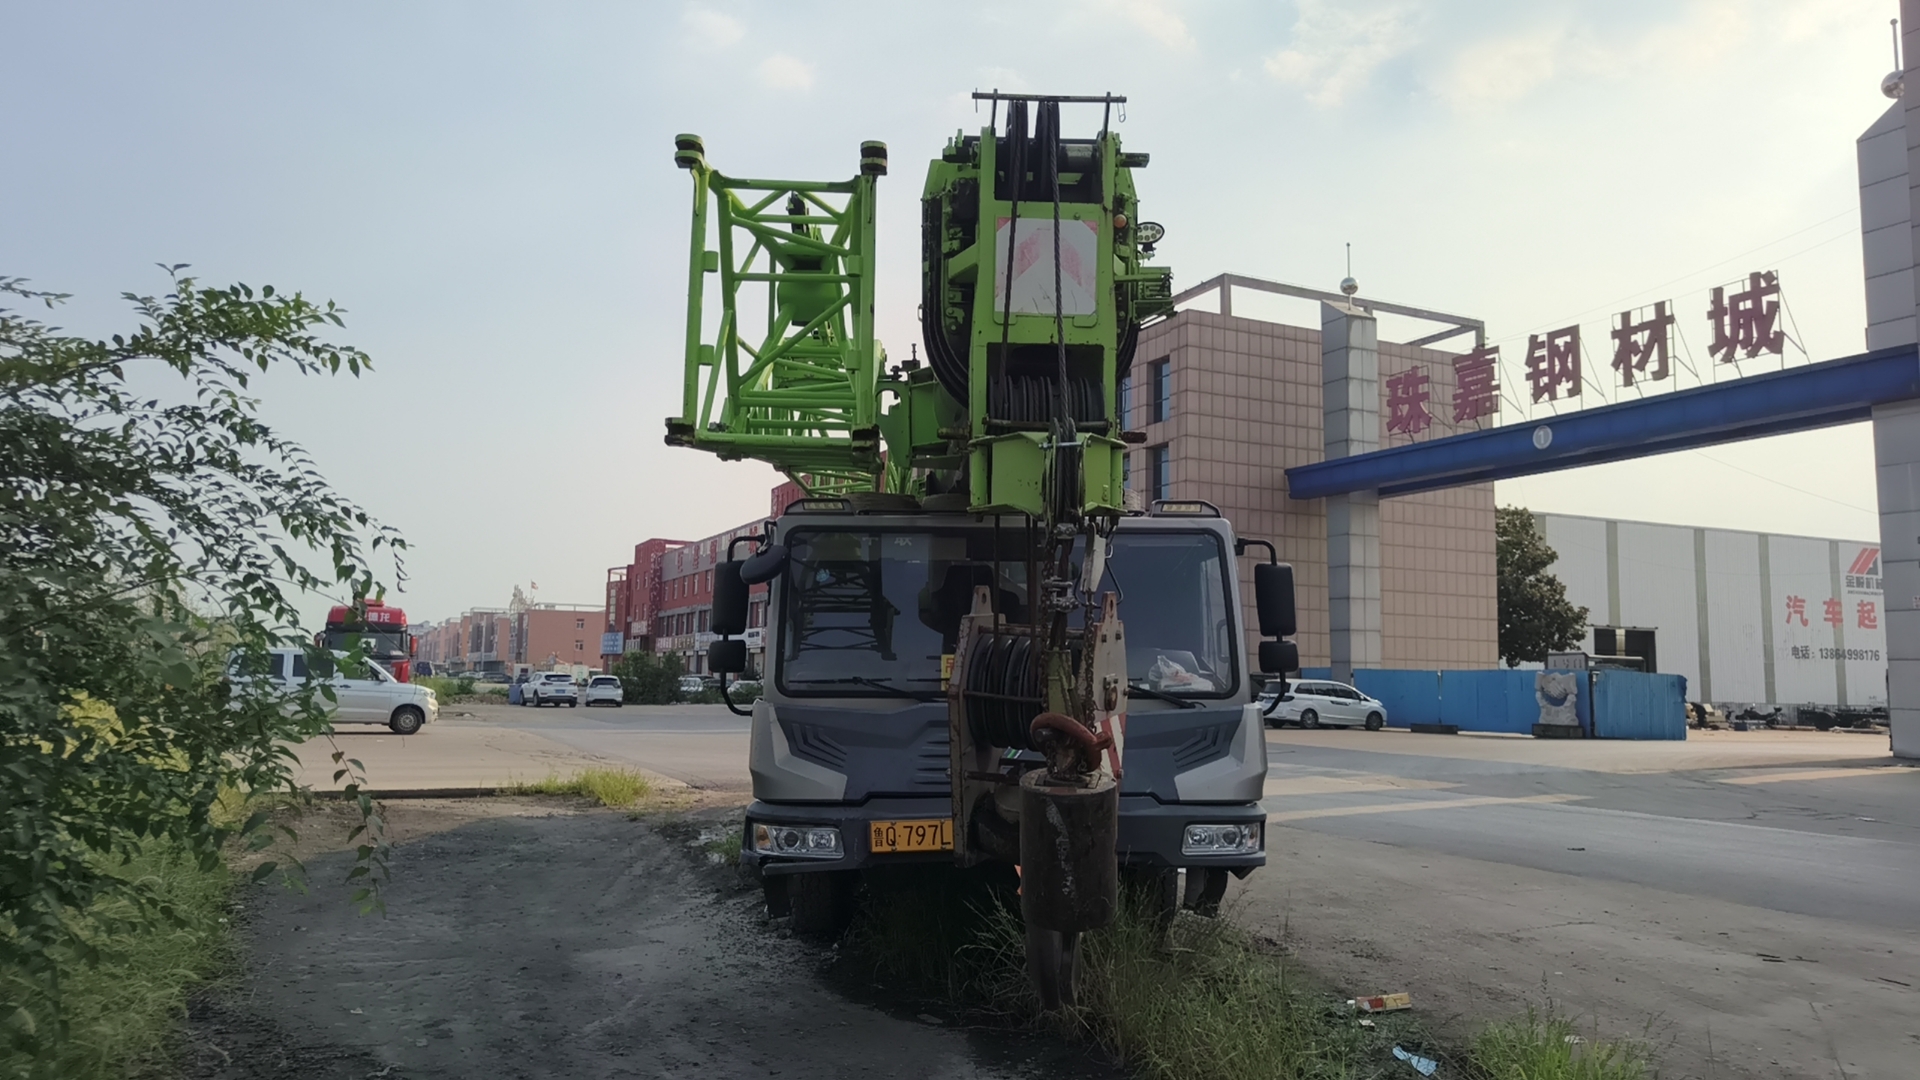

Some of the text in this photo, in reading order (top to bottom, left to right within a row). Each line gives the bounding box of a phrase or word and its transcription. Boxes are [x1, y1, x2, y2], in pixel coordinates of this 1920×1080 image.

[1386, 270, 1784, 435] 珠嘉钢材城
[364, 611, 391, 623] 德龙
[1785, 595, 1878, 630] 汽车起
[873, 823, 953, 848] 鲁Q·797L
